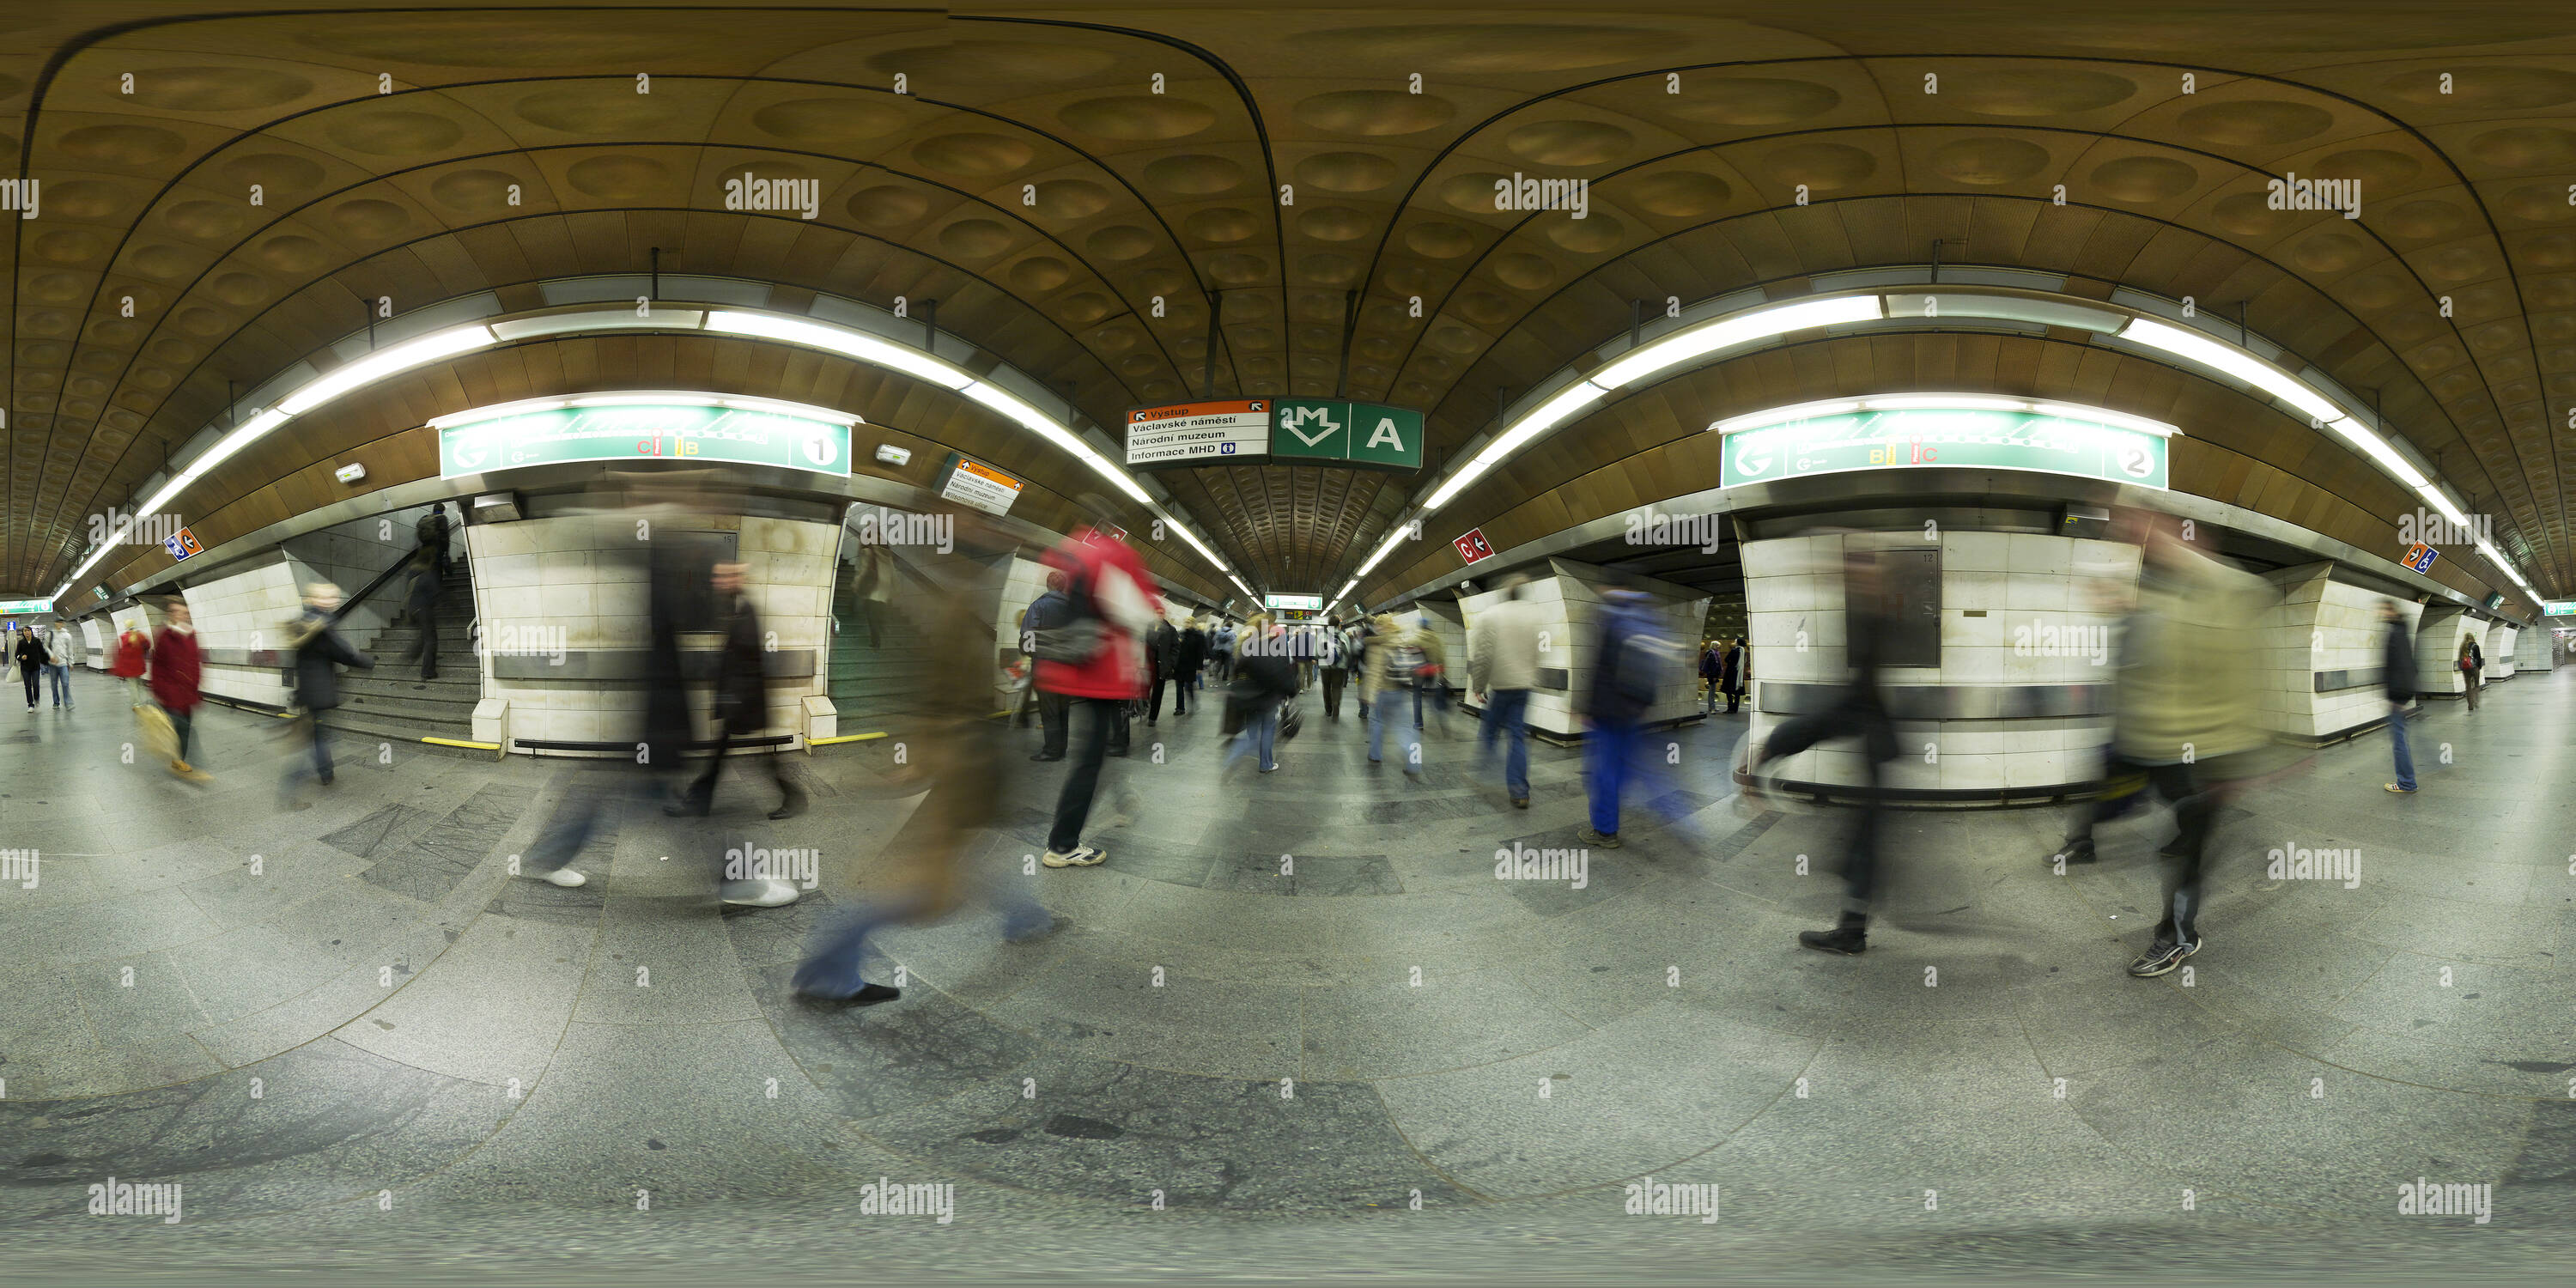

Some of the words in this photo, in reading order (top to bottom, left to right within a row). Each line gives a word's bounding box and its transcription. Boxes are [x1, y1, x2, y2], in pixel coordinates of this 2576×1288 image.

[1151, 408, 1188, 419] Výstup
[1133, 419, 1187, 433] Václavské
[1191, 416, 1236, 426] náměstí
[1132, 434, 1174, 447] Národní
[1177, 431, 1225, 441] muzeum
[1366, 417, 1405, 453] A
[637, 440, 651, 454] C
[685, 442, 699, 455] B
[812, 438, 823, 460] 1
[1132, 448, 1185, 460] Informace
[1188, 445, 1216, 454] MHD
[1922, 447, 1938, 462] C
[1869, 449, 1884, 465] B
[2126, 448, 2145, 474] 2
[945, 490, 974, 505] Wilsonova
[975, 501, 988, 509] ulice
[974, 489, 996, 501] muzeum
[1461, 543, 1473, 558] C
[1923, 554, 1934, 562] 12
